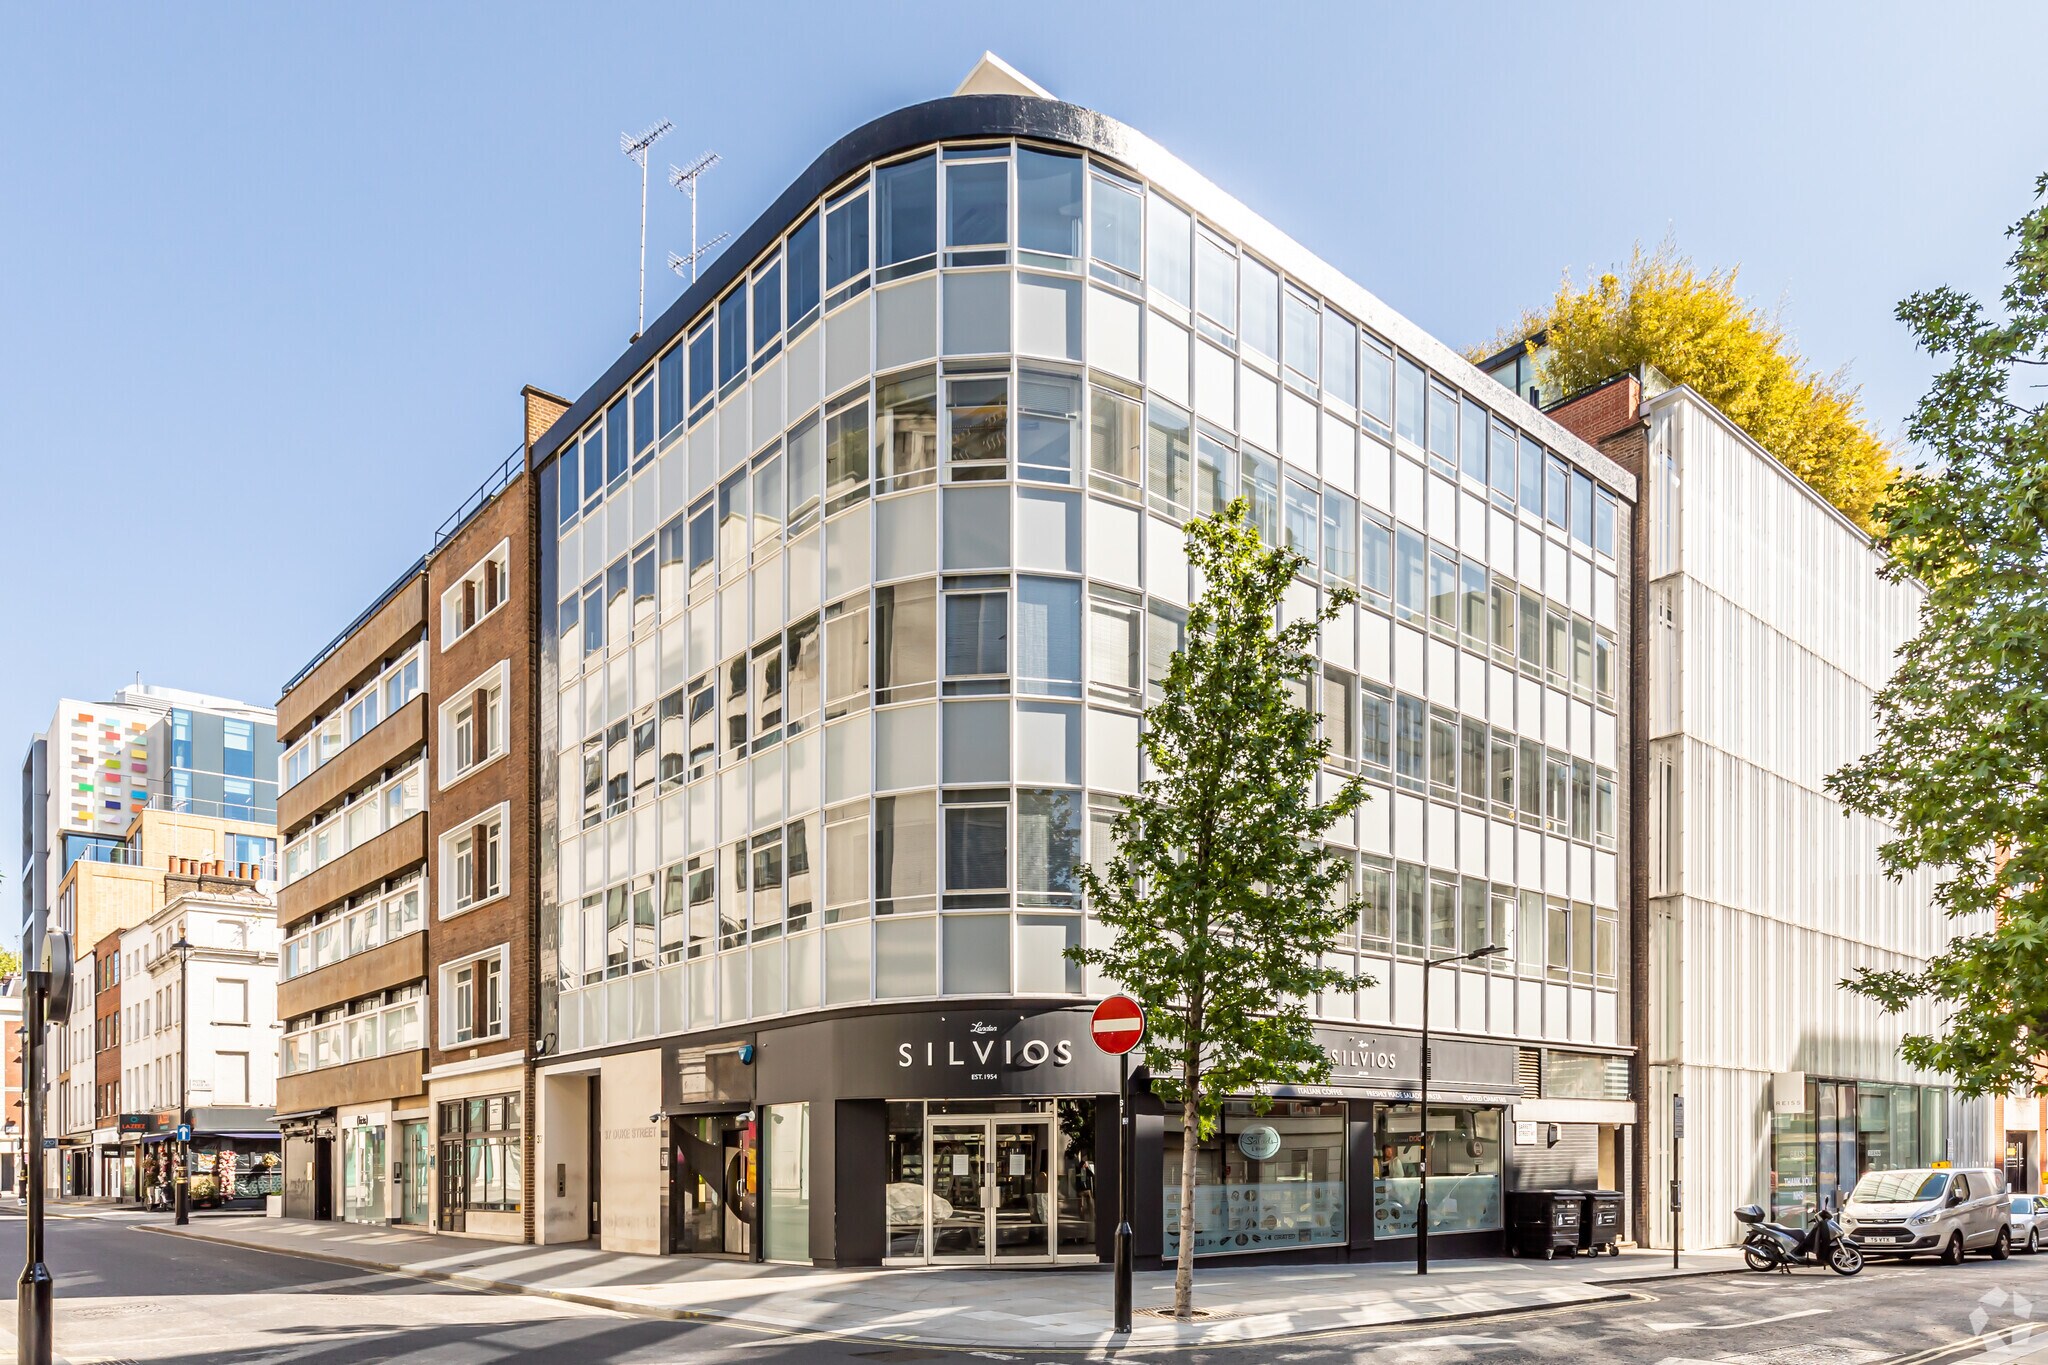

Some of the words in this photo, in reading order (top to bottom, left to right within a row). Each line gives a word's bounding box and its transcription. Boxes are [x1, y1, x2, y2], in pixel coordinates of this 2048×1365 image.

[970, 1021, 998, 1034] London
[899, 1040, 1072, 1067] SILVIOS
[1331, 1048, 1396, 1069] SILVIOS
[1297, 1087, 1321, 1095] ITALIAN
[1322, 1088, 1344, 1096] COFFEE
[613, 1128, 631, 1140] DUKE
[631, 1126, 657, 1139] STREET
